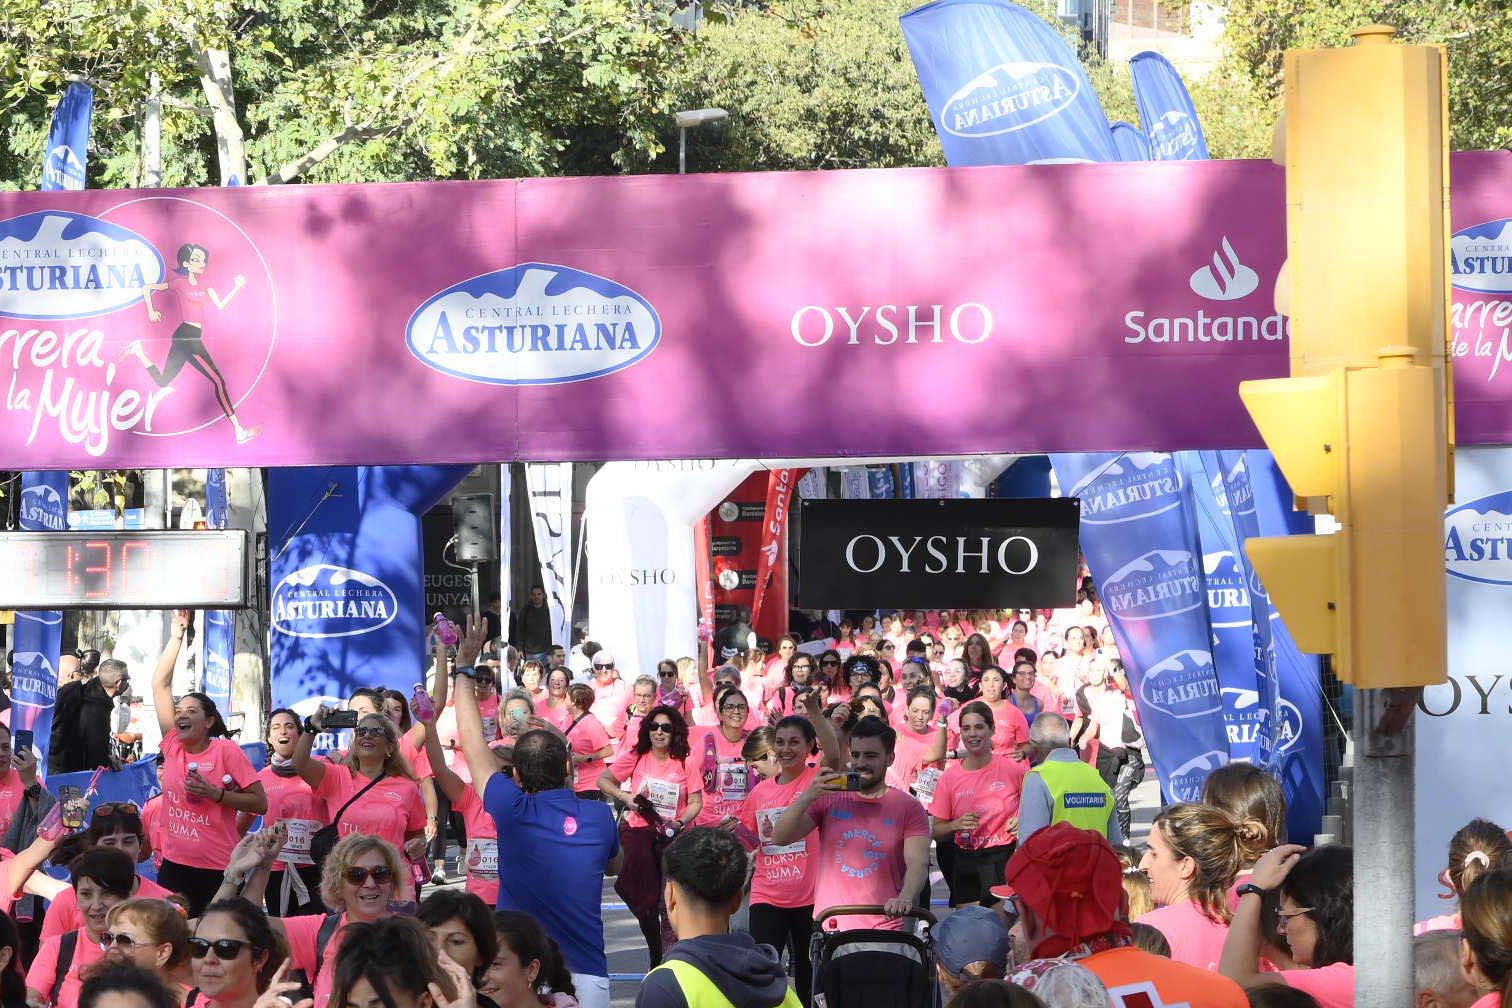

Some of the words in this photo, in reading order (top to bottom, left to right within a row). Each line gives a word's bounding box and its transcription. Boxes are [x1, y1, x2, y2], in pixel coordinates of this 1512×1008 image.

[1465, 244, 1512, 254] CENTRA
[466, 306, 544, 319] CENTRAL
[551, 303, 633, 317] LECHERA
[425, 309, 642, 355] ASTURIANA
[790, 302, 993, 347] OYSHO
[1124, 309, 1292, 344] Santand
[1475, 331, 1493, 357] la
[7, 371, 32, 412] la
[25, 365, 177, 457] Mujer
[1472, 522, 1512, 533] CENT
[845, 533, 1040, 575] OYSHO
[1206, 577, 1234, 587] TRAL
[288, 589, 330, 598] CENTRAL
[334, 588, 383, 598] LECHERA
[275, 594, 389, 623] ASTURIANA
[1415, 673, 1512, 717] OY
[167, 790, 180, 803] TU
[650, 792, 664, 800] 016
[168, 806, 210, 826] DORSAL
[168, 821, 199, 838] SUMA
[342, 822, 358, 833] TU
[288, 836, 305, 844] 016
[766, 866, 801, 880] SUMA
